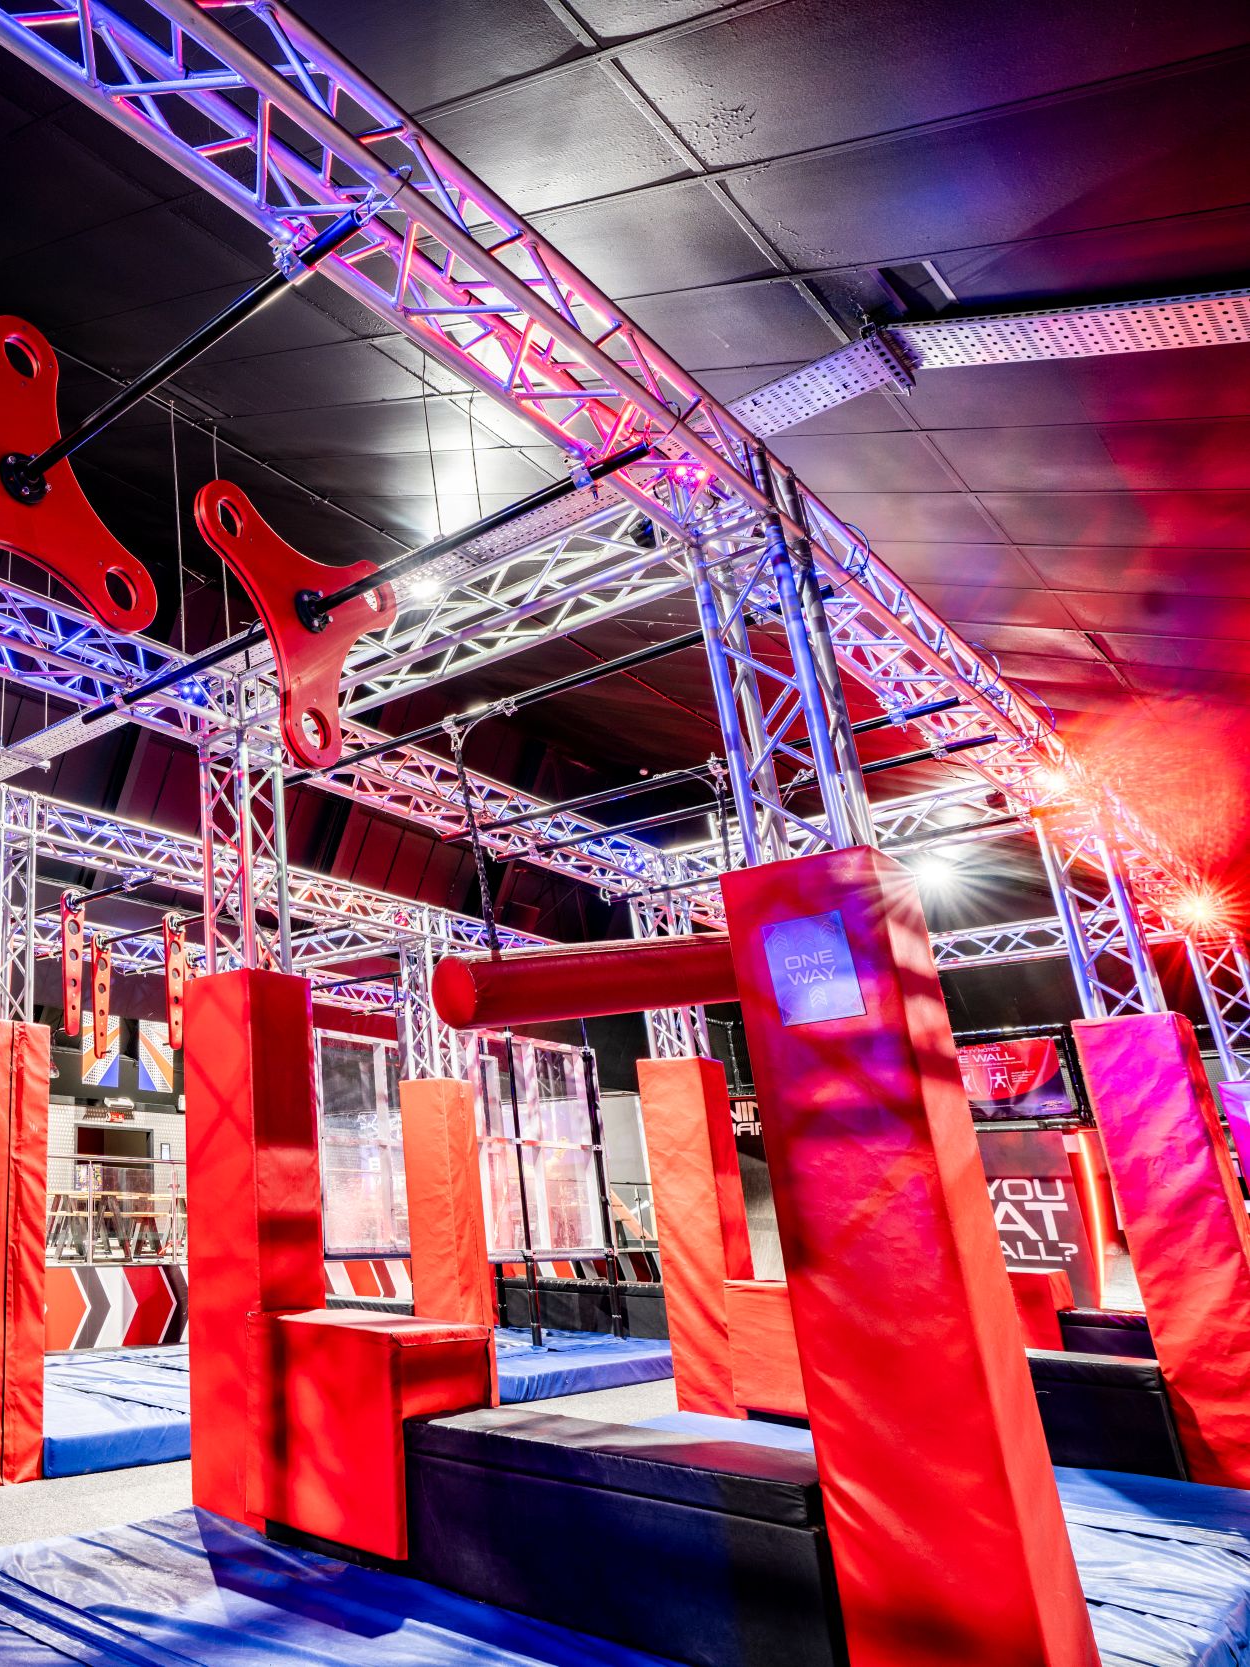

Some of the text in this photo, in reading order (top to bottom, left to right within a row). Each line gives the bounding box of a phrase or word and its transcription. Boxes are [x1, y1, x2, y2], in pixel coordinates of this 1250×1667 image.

[784, 949, 834, 970] ONE
[787, 965, 836, 986] WAY
[957, 1055, 969, 1064] E
[972, 1052, 1016, 1063] WALL
[987, 1178, 1065, 1200] YOU
[994, 1201, 1069, 1241] AT
